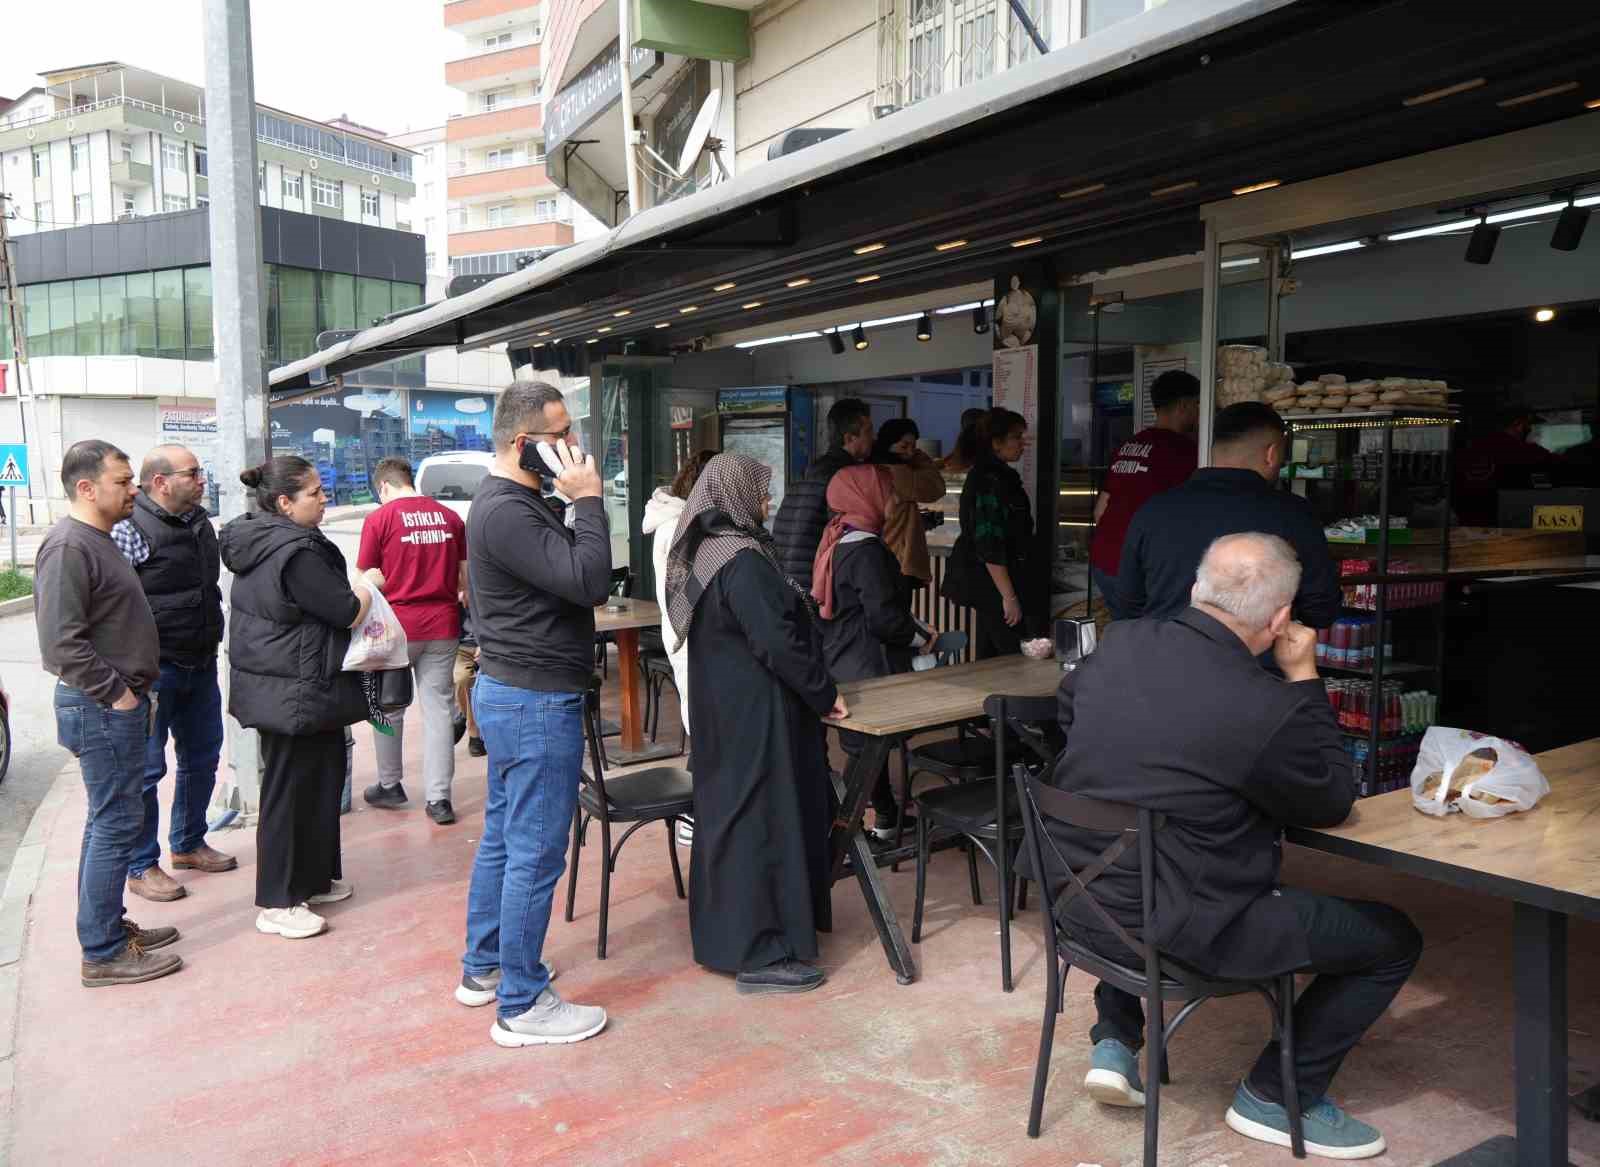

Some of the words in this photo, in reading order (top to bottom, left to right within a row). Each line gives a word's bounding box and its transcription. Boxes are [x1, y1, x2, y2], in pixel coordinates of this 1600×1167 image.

[401, 509, 447, 527] İSTİKLAL
[1538, 513, 1577, 527] KASA
[413, 529, 442, 544] FIRINI
